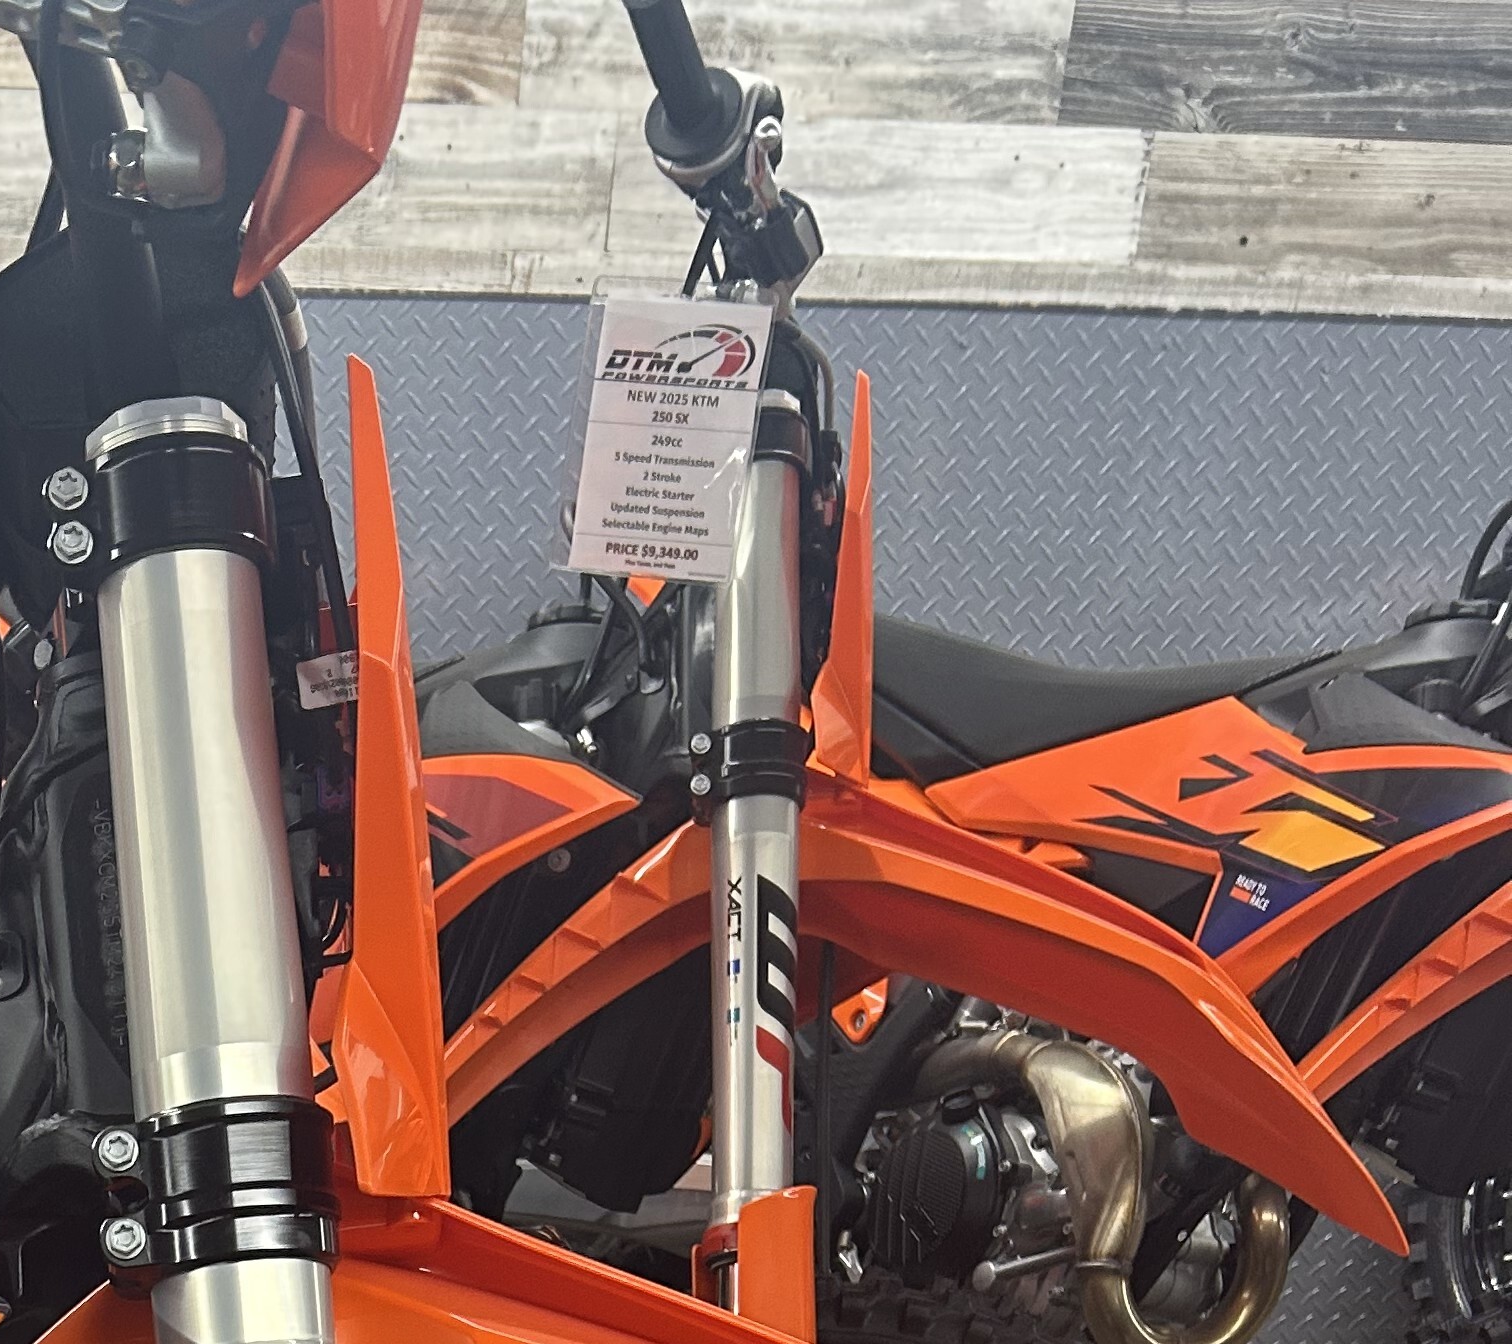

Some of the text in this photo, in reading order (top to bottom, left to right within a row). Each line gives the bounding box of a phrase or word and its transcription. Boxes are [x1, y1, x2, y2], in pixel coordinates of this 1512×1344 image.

[605, 350, 678, 373] DTM
[601, 372, 748, 389] POWERSPORTS
[626, 390, 720, 408] NEW 2025 KTM
[651, 411, 689, 425] 250 SX
[651, 435, 683, 448] 249cc
[622, 452, 652, 465] Speed
[654, 453, 715, 469] Transmission
[643, 472, 681, 483] 2 Stroke
[626, 486, 694, 501] Electric Starter
[610, 502, 705, 519] Updated Suspension
[602, 518, 709, 538] Selectable Engine Maps
[606, 542, 698, 561] PRICE $9,349.00
[1255, 882, 1268, 896] TO
[1249, 894, 1270, 912] RACE
